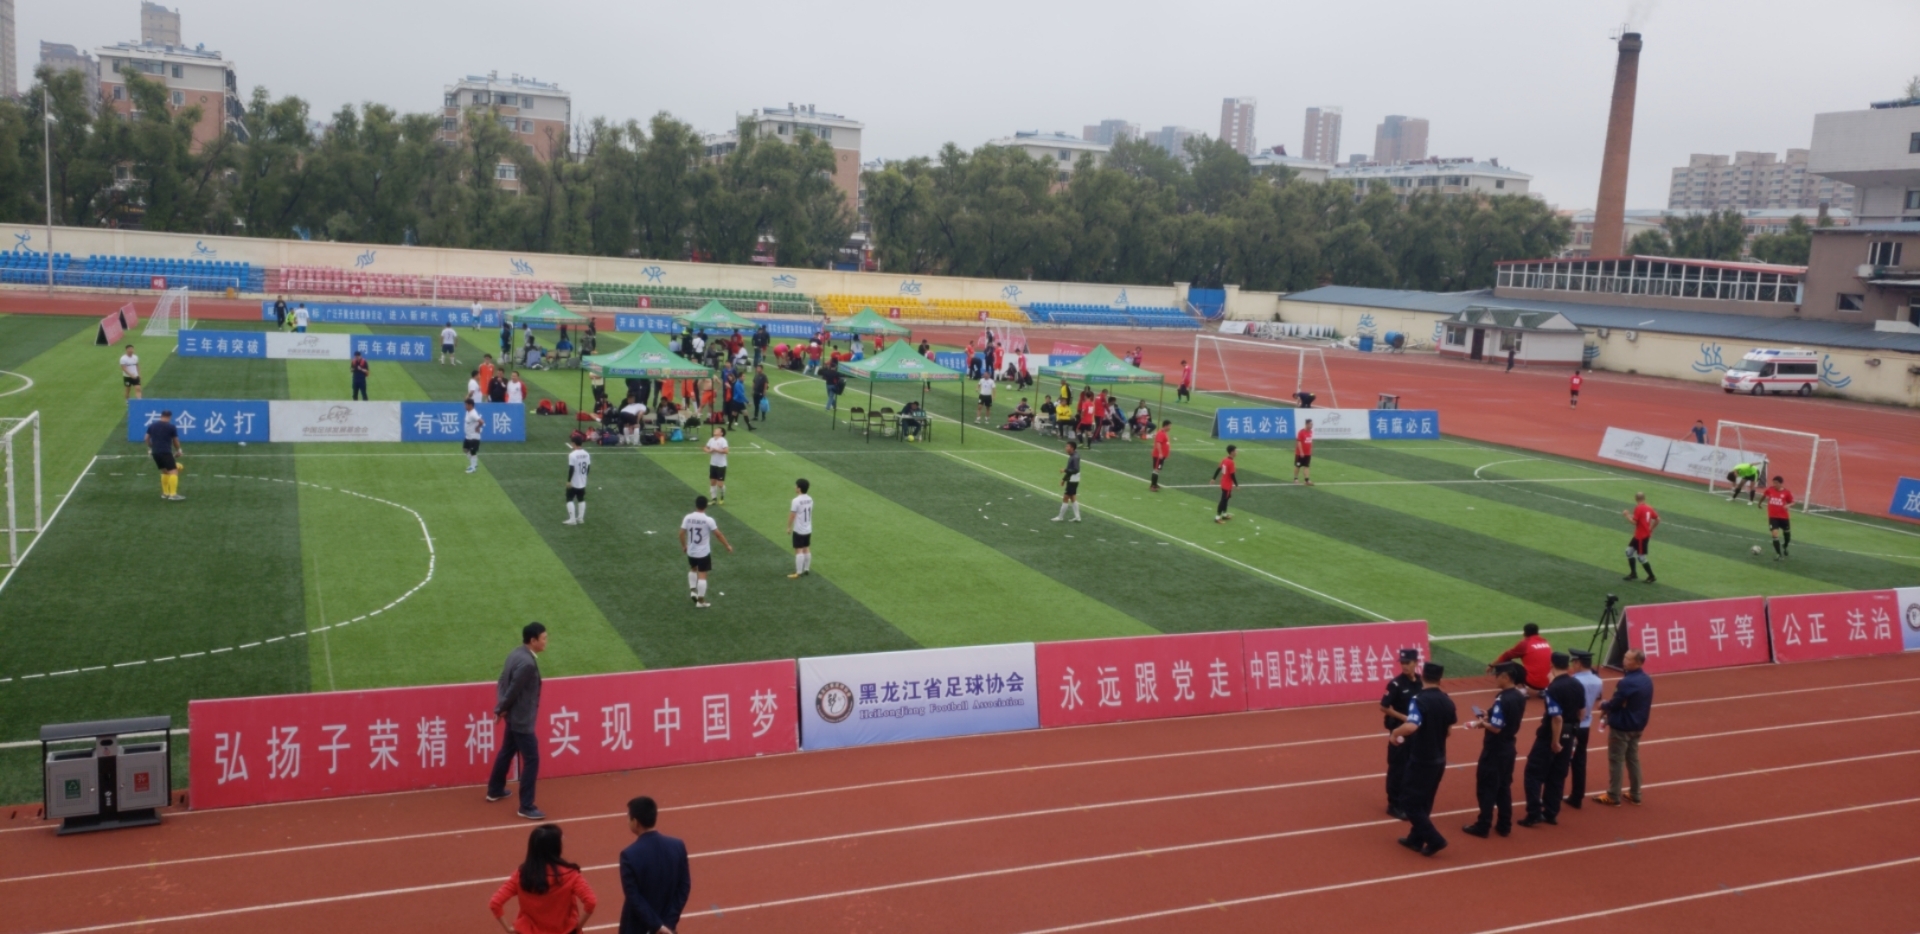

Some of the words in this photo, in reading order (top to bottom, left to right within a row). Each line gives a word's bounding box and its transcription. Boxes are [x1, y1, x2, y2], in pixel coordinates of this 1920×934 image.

[389, 309, 438, 321] 进入新时代
[448, 311, 493, 323] 快乐球
[186, 337, 259, 354] 三年有突破
[358, 340, 425, 356] 两年有成效
[414, 411, 512, 436] 有恶除
[1227, 416, 1288, 434] 有乱必治
[1376, 417, 1432, 434] 有腐必反
[578, 461, 587, 475] 18
[803, 507, 811, 522] 11
[689, 527, 702, 544] 13
[1782, 612, 1828, 646] 公正
[1846, 606, 1893, 641] 法治
[1641, 620, 1688, 657] 自由
[1709, 614, 1755, 651] 平等
[1250, 642, 1425, 690] 中国足球发展基金会
[858, 671, 1024, 705] 黑龙江省足球协会
[1060, 657, 1231, 711] 永远跟党走
[929, 700, 968, 714] Football
[972, 696, 1024, 710] Association
[214, 711, 495, 785] 弘扬子荣精神
[548, 688, 778, 758] 实现中国梦
